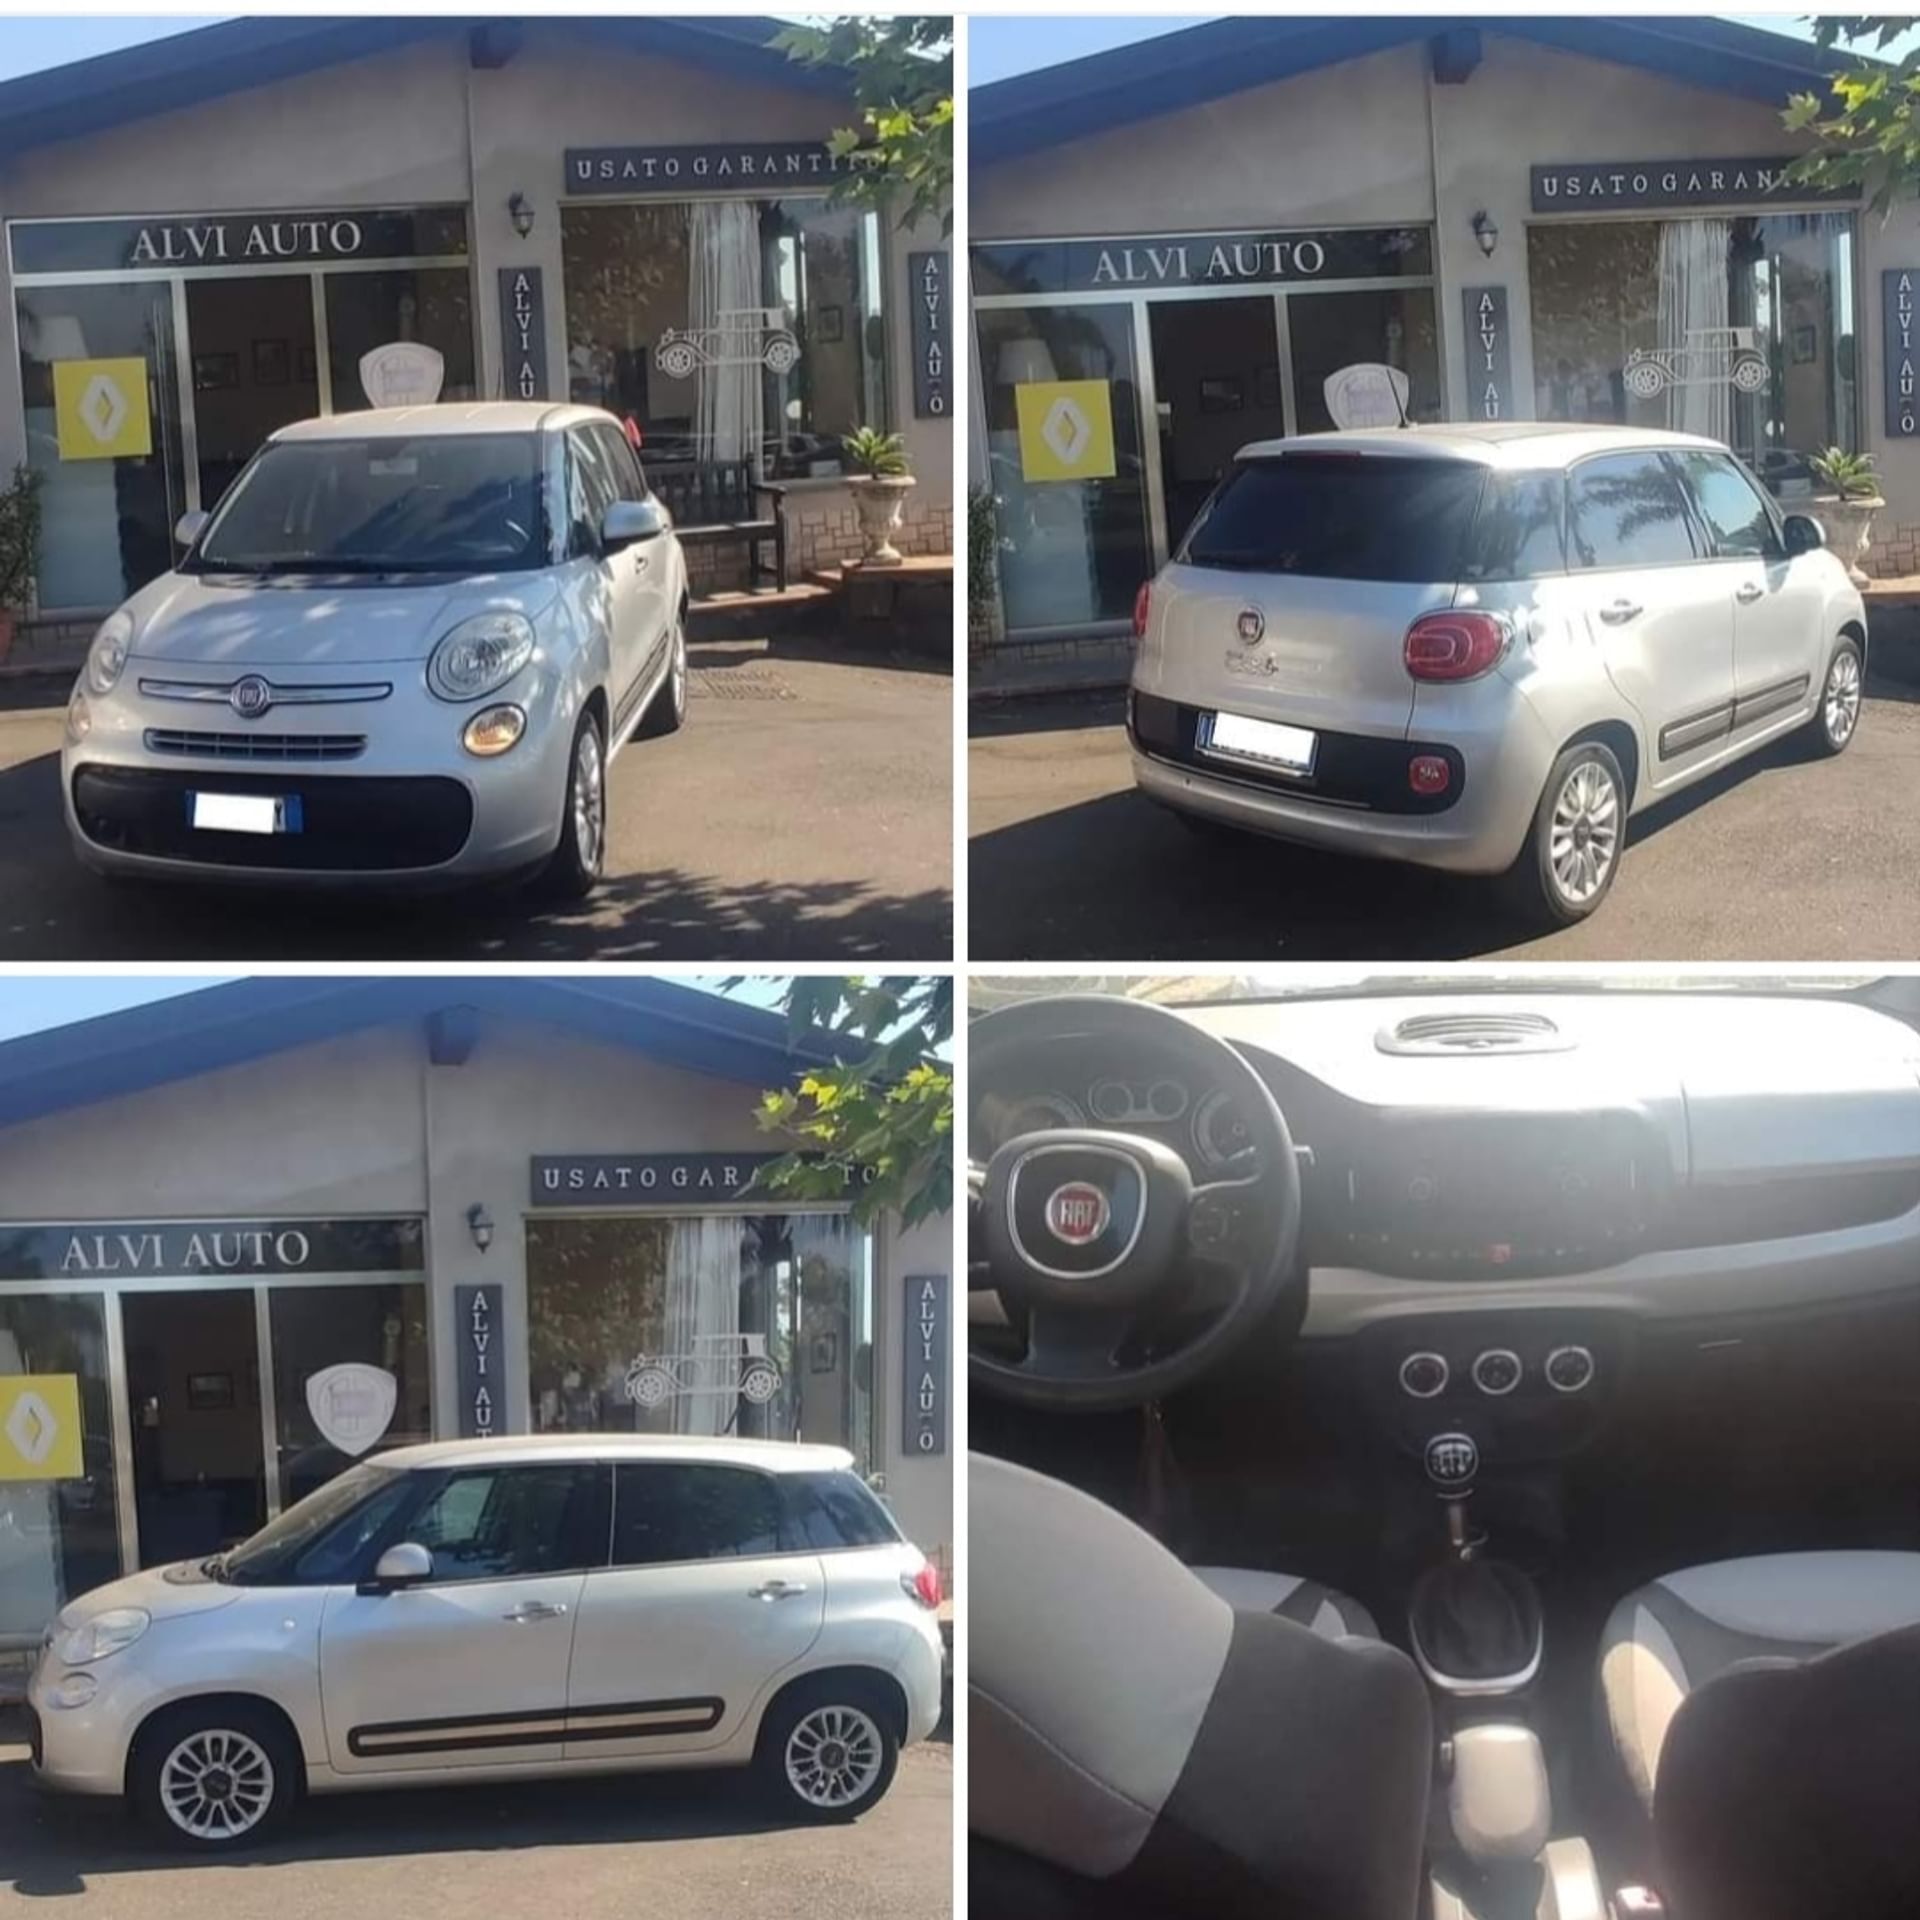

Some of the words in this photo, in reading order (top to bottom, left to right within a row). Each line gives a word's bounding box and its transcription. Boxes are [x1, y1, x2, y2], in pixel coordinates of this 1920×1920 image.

[576, 157, 681, 179] USATO
[1542, 174, 1649, 197] USATO
[131, 224, 229, 263] ALVI
[244, 219, 363, 257] AUTO
[1092, 245, 1189, 283] ALVI
[1204, 239, 1326, 279] AUTO
[512, 272, 531, 351] ALVI
[922, 255, 939, 330] ALVI
[1898, 272, 1914, 350] ALVI
[1478, 292, 1497, 371] ALVI
[518, 361, 537, 399] AU
[1483, 381, 1500, 420] AU
[543, 1166, 658, 1189] USATO
[60, 1233, 164, 1272] ALVI
[180, 1229, 311, 1269] AUTO
[471, 1289, 490, 1375] ALVI
[920, 1280, 937, 1360] ALVI
[475, 1385, 493, 1438] AUT
